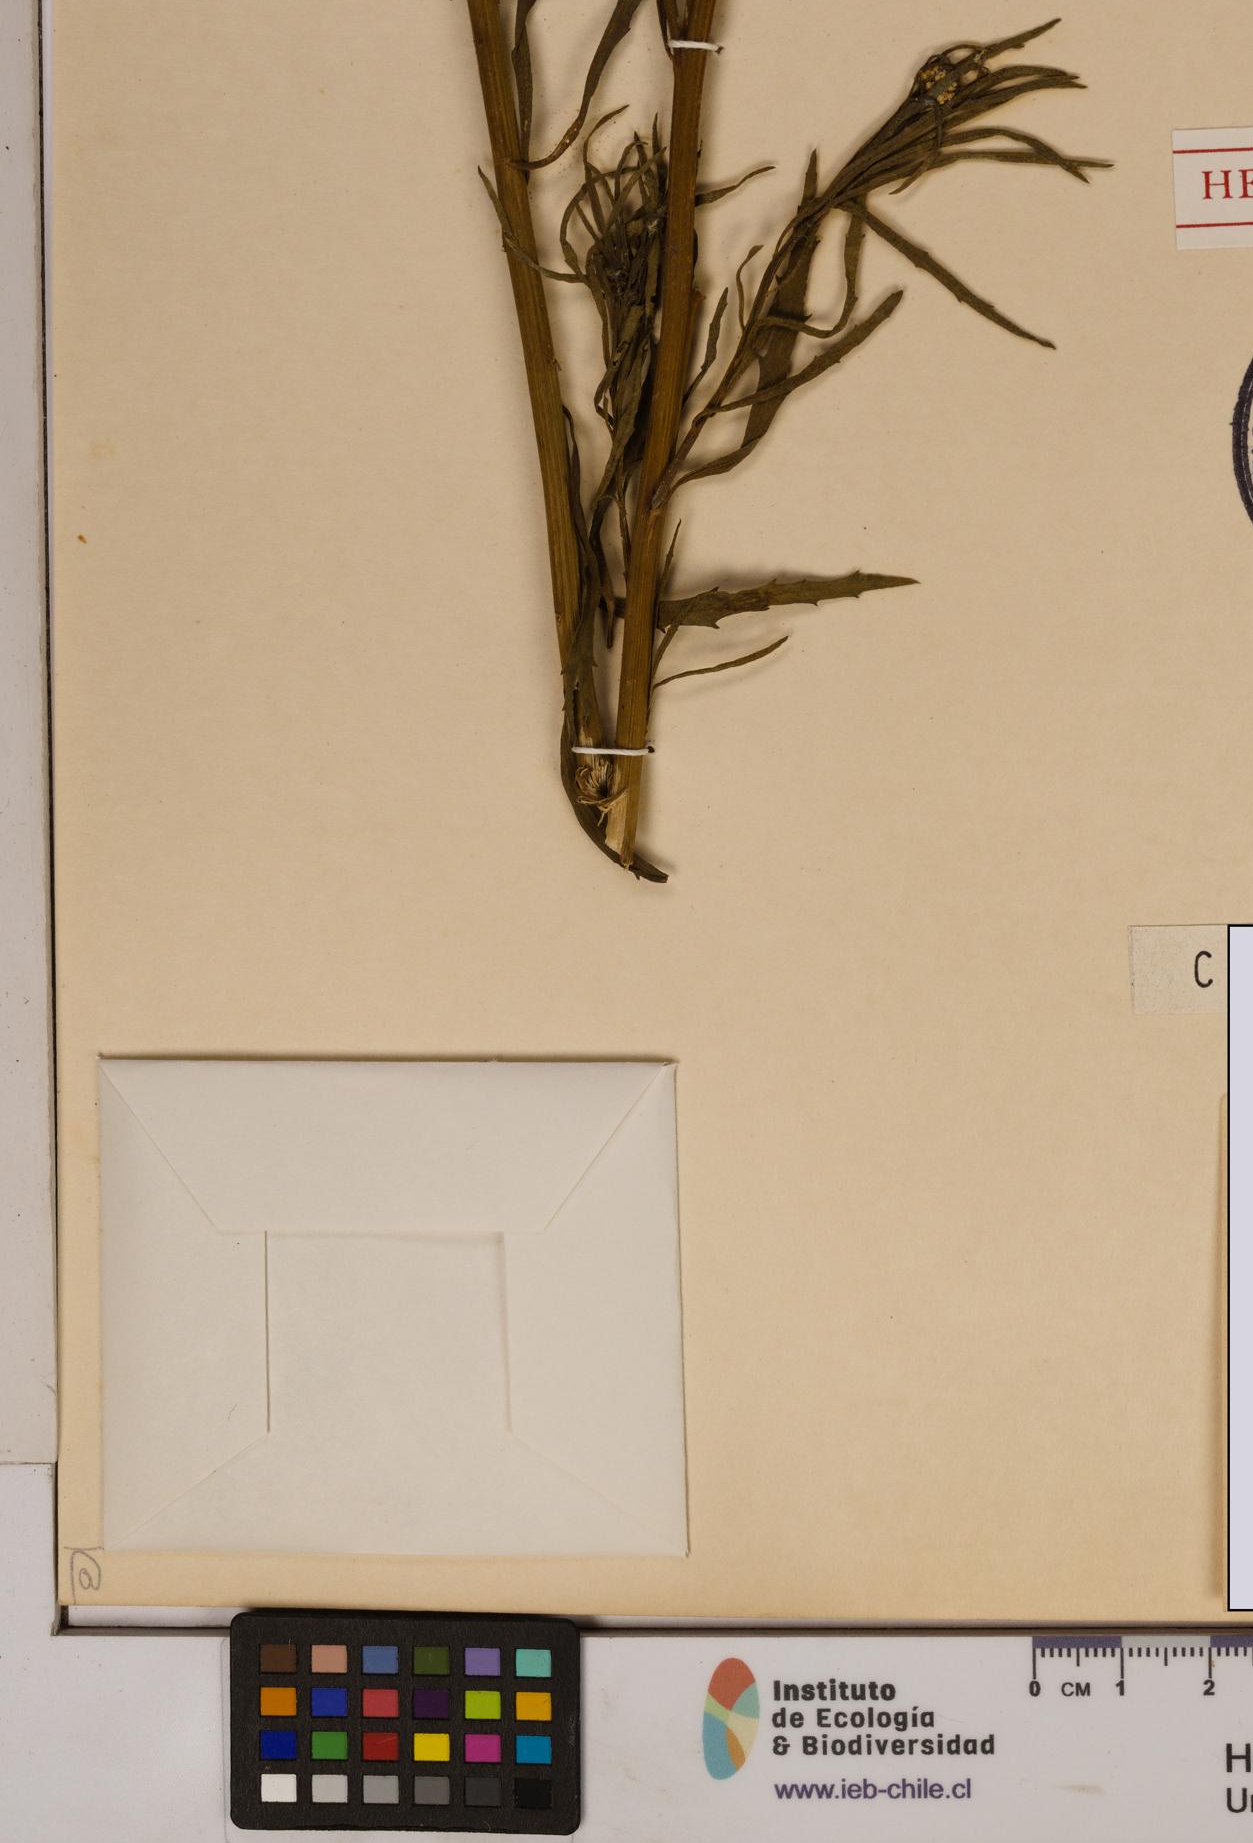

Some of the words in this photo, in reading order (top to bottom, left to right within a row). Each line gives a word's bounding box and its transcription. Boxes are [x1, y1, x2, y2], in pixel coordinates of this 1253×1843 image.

[773, 1677, 897, 1702] Instituto
[1028, 1680, 1042, 1698] 0
[1060, 1681, 1091, 1697] CM
[1115, 1679, 1125, 1697] 1
[1202, 1679, 1216, 1696] 2
[771, 1706, 805, 1729] de
[816, 1705, 935, 1733] Ecología
[772, 1735, 791, 1756] &
[802, 1733, 995, 1756] Biodiversidad
[774, 1777, 972, 1800] www.ieb-chile.cl
